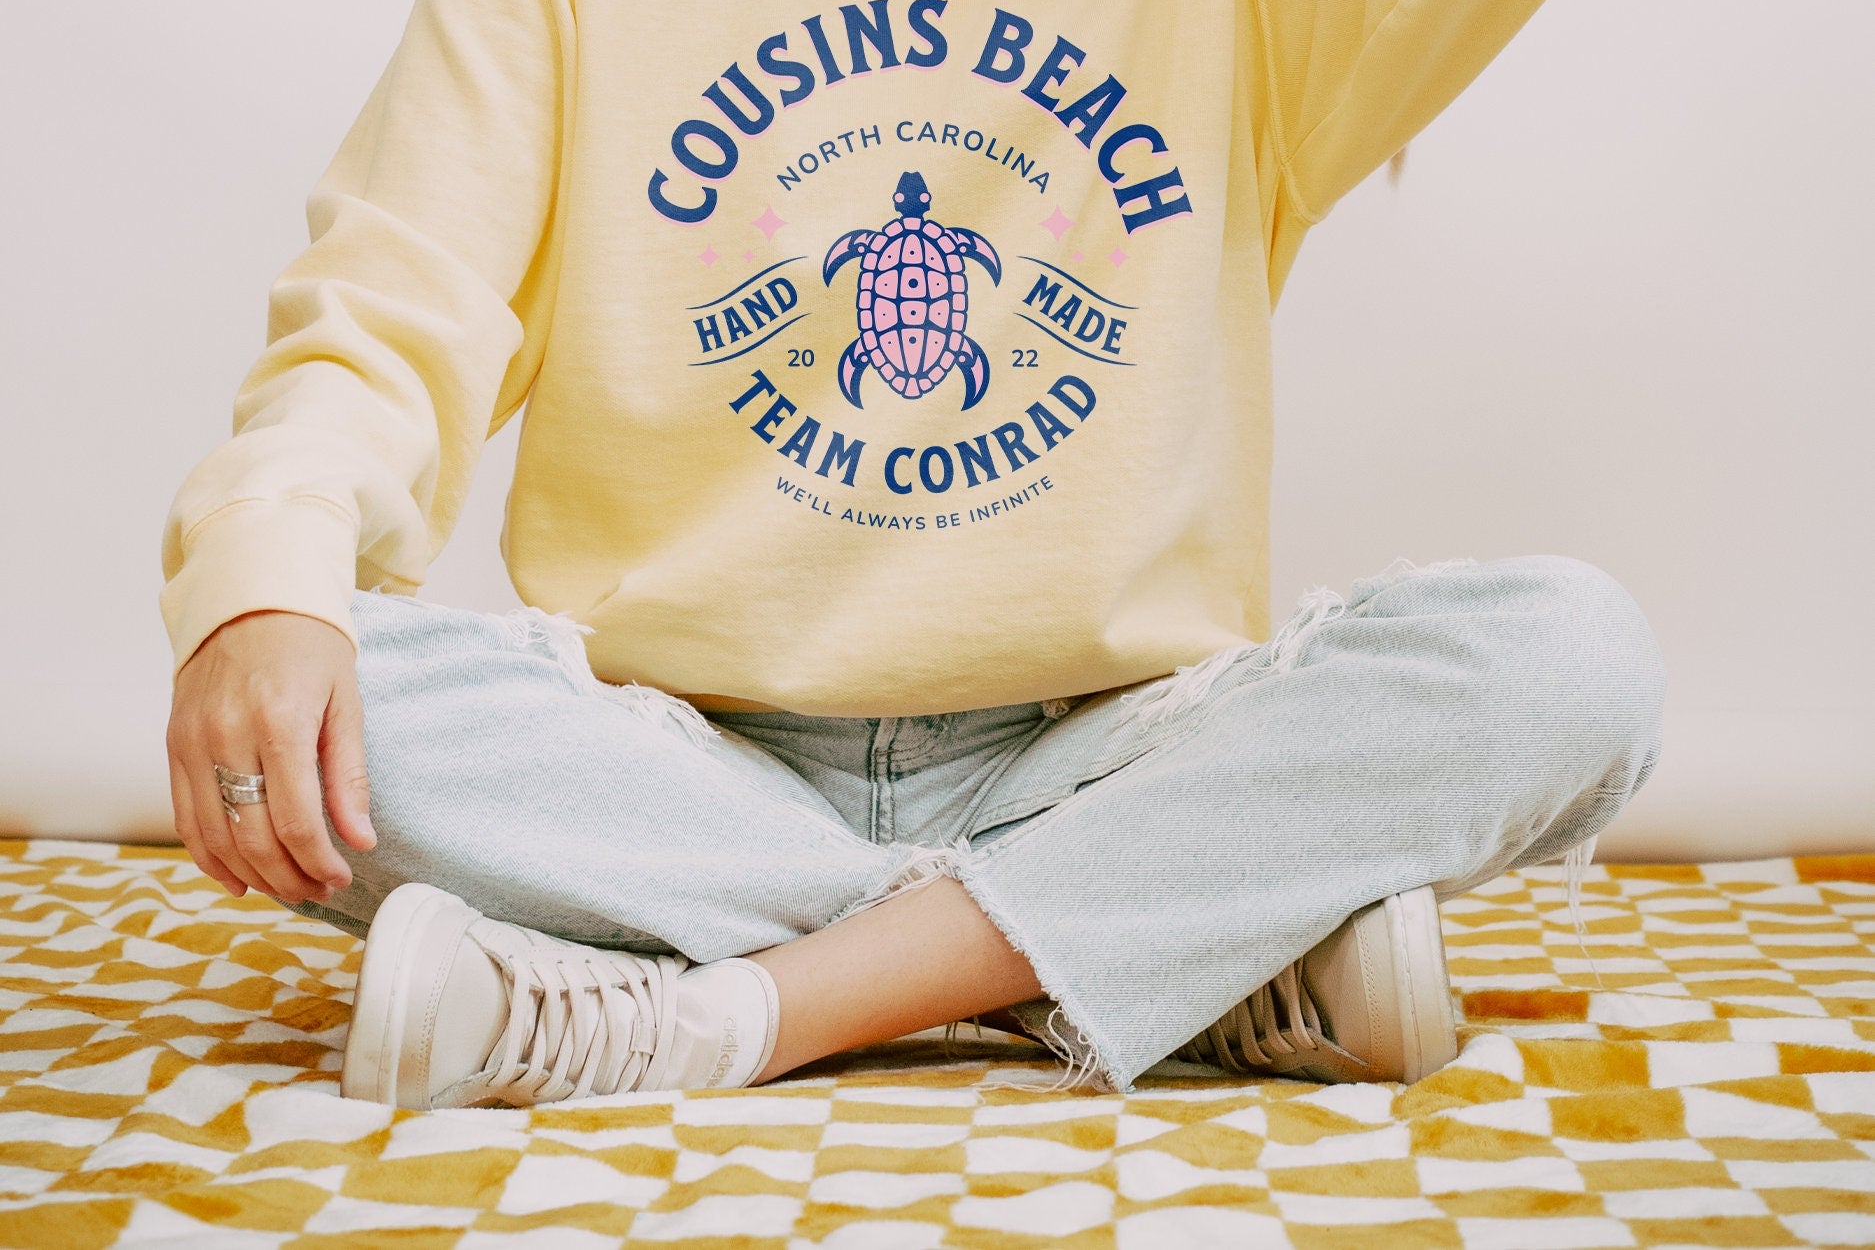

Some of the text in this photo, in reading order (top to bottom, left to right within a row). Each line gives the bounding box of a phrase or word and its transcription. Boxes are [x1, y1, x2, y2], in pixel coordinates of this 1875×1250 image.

[776, 121, 1050, 195] NORTH CAROLINA
[972, 8, 1193, 235] BEACH
[693, 277, 798, 354] HAND
[1021, 273, 1128, 355] MADE
[787, 348, 815, 368] 20
[1011, 349, 1039, 368] 22
[729, 369, 1097, 495] TEAM CONRAD
[776, 475, 1054, 531] WE'LL ALWAYS BE INFINITE
